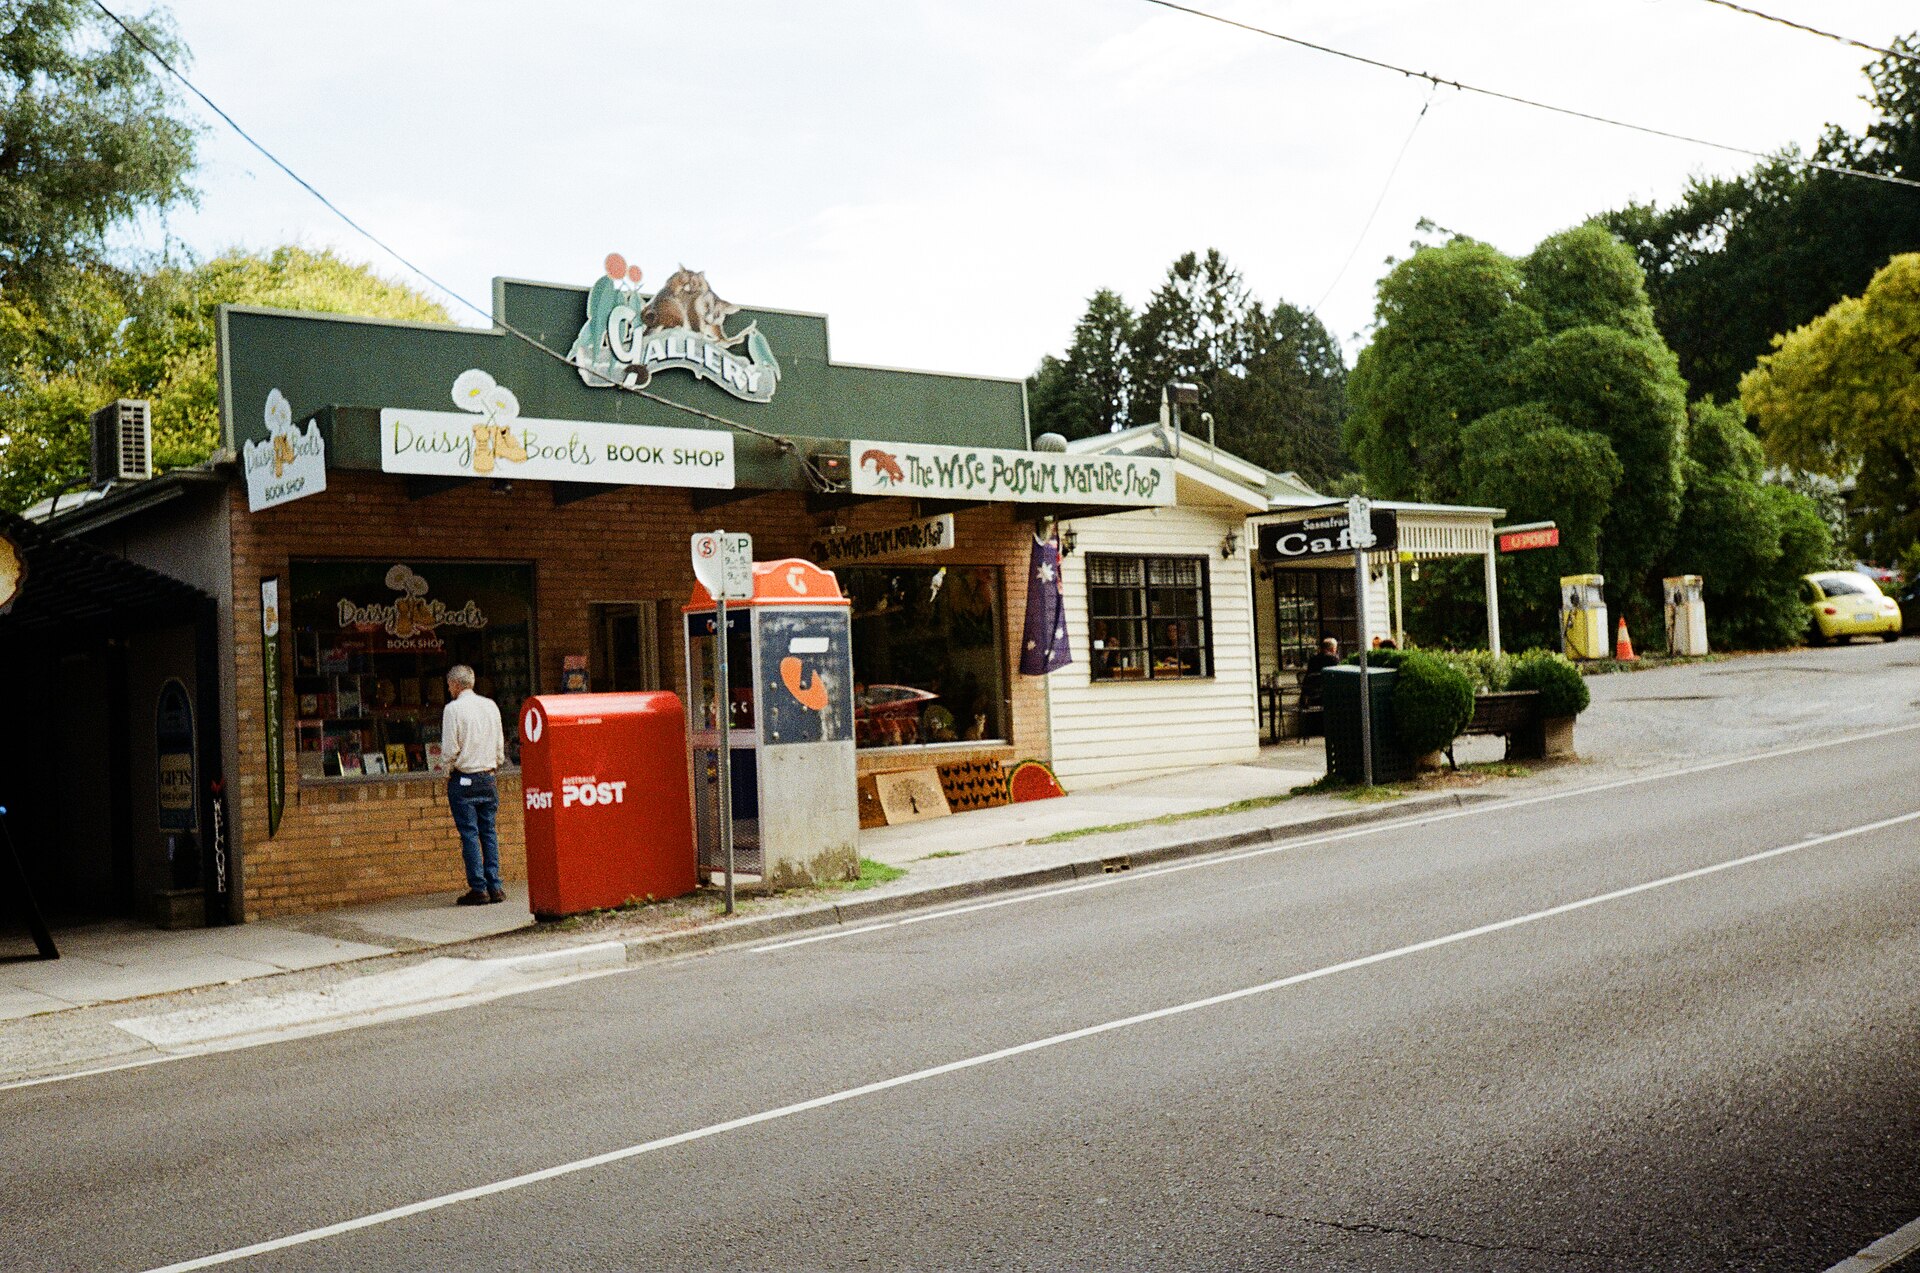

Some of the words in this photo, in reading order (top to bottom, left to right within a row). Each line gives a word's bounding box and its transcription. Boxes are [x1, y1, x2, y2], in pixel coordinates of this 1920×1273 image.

[608, 305, 762, 393] GALLERY
[391, 420, 471, 468] Daisy
[522, 428, 596, 466] Boots
[606, 444, 664, 465] BOOK
[673, 448, 725, 468] SHOP
[906, 454, 934, 488] The
[738, 538, 749, 554] P
[337, 599, 395, 634] Daisy
[430, 599, 488, 628] Boots
[387, 639, 415, 649] BOOK
[417, 638, 444, 649] SHOP
[526, 791, 553, 810] POST
[562, 781, 627, 808] POST
